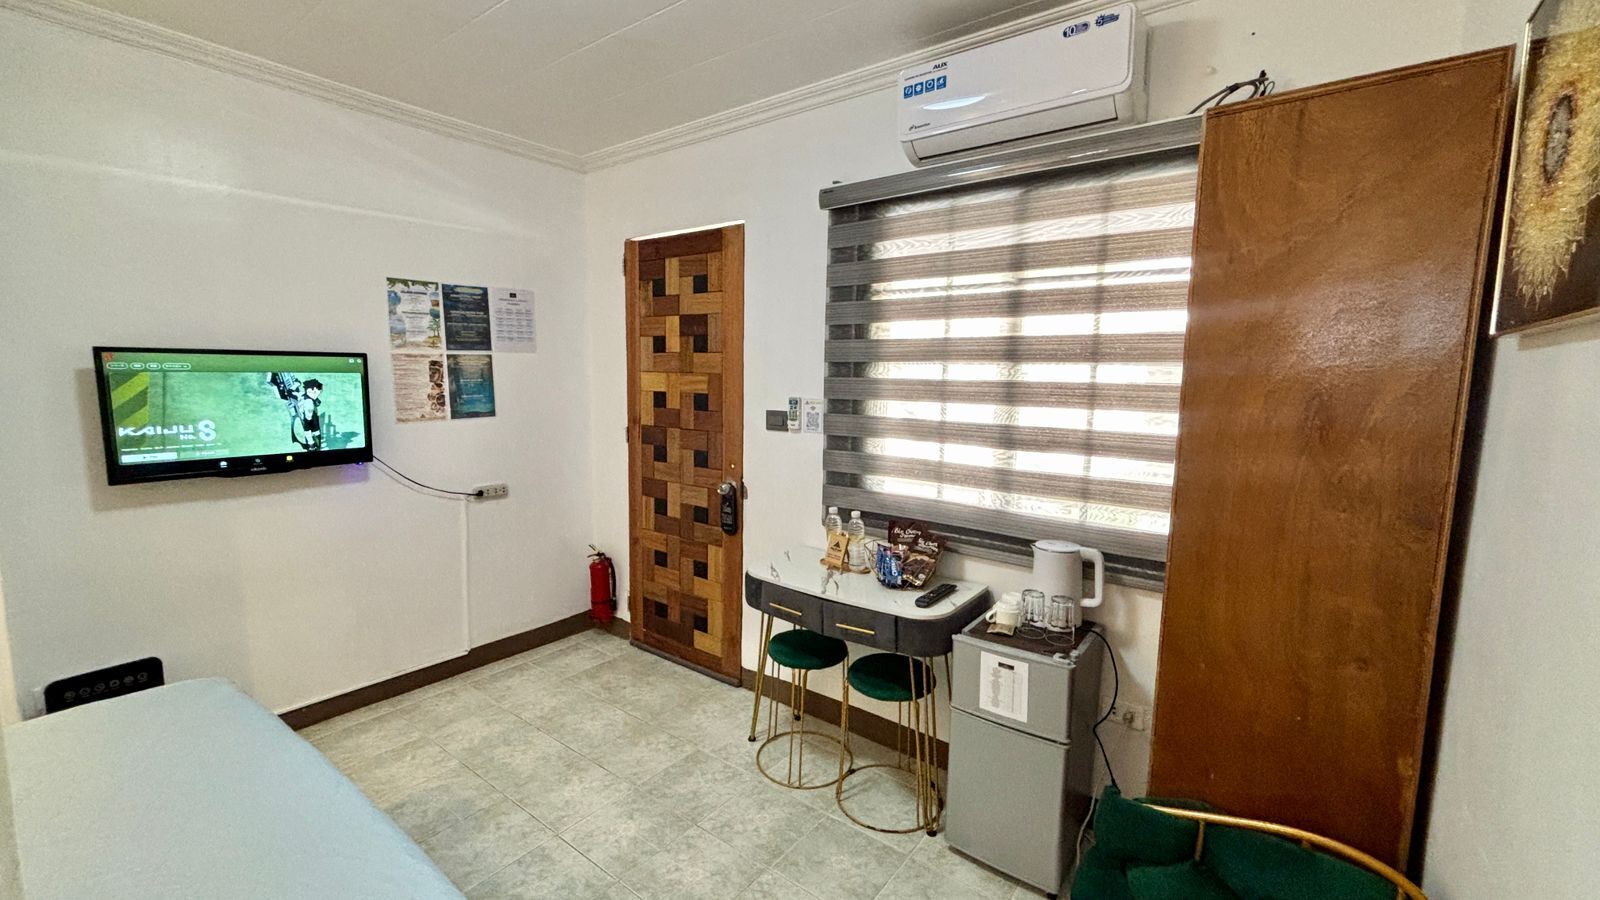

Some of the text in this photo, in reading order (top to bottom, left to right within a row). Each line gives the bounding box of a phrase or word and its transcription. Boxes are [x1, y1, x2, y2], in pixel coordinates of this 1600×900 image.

[932, 61, 949, 69] AUX
[118, 424, 194, 436] KAIJU
[198, 419, 217, 441] 8
